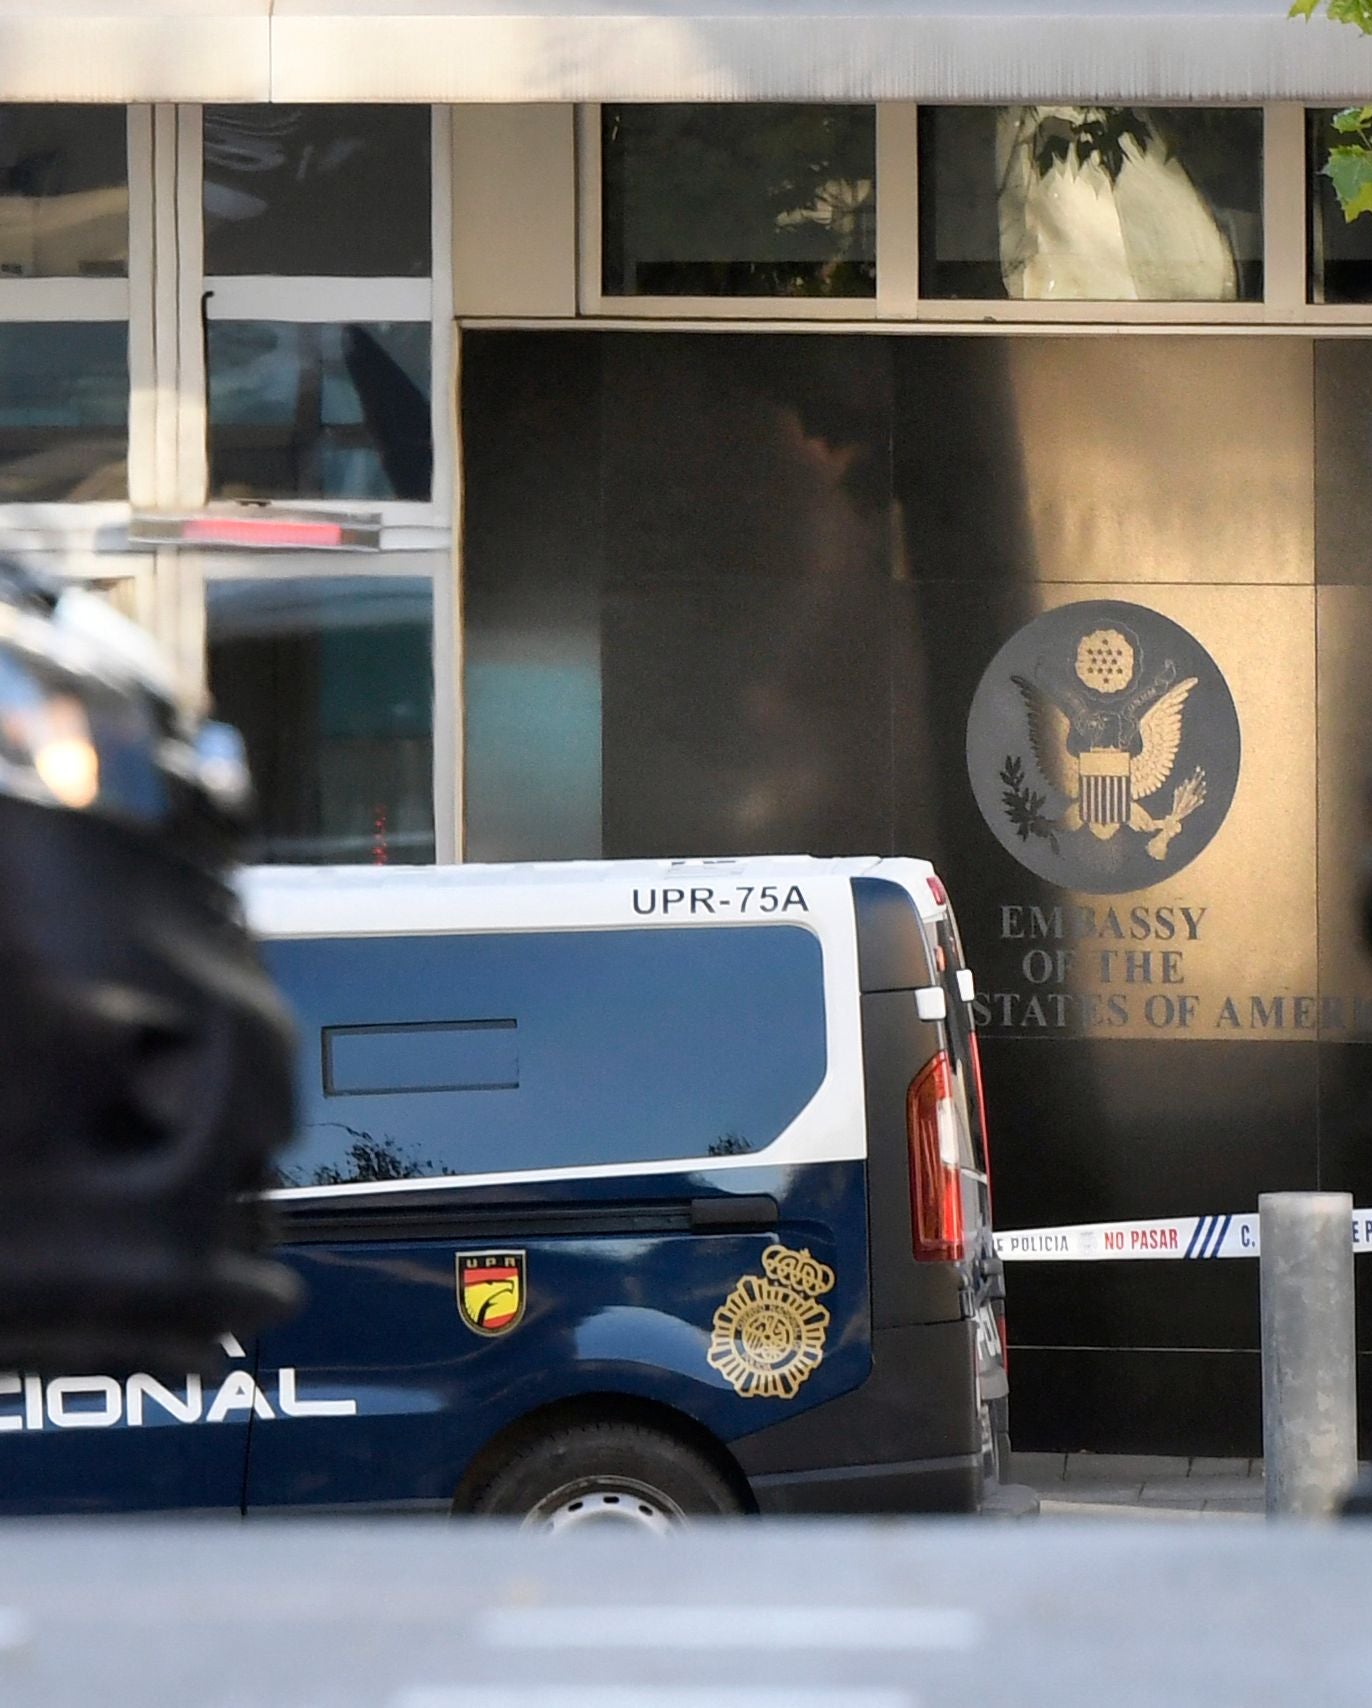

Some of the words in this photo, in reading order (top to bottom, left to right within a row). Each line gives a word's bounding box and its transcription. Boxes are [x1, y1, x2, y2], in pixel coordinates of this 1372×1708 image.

[632, 885, 809, 915] UPR-75A
[1000, 905, 1208, 941] EMBASSY
[1022, 948, 1074, 985] OF
[1098, 950, 1185, 985] THE
[972, 992, 1129, 1029] STATES
[1144, 993, 1200, 1029] OF
[1011, 1235, 1069, 1252] POLICIA
[1104, 1231, 1125, 1251] NO
[1131, 1228, 1179, 1250] PASAR
